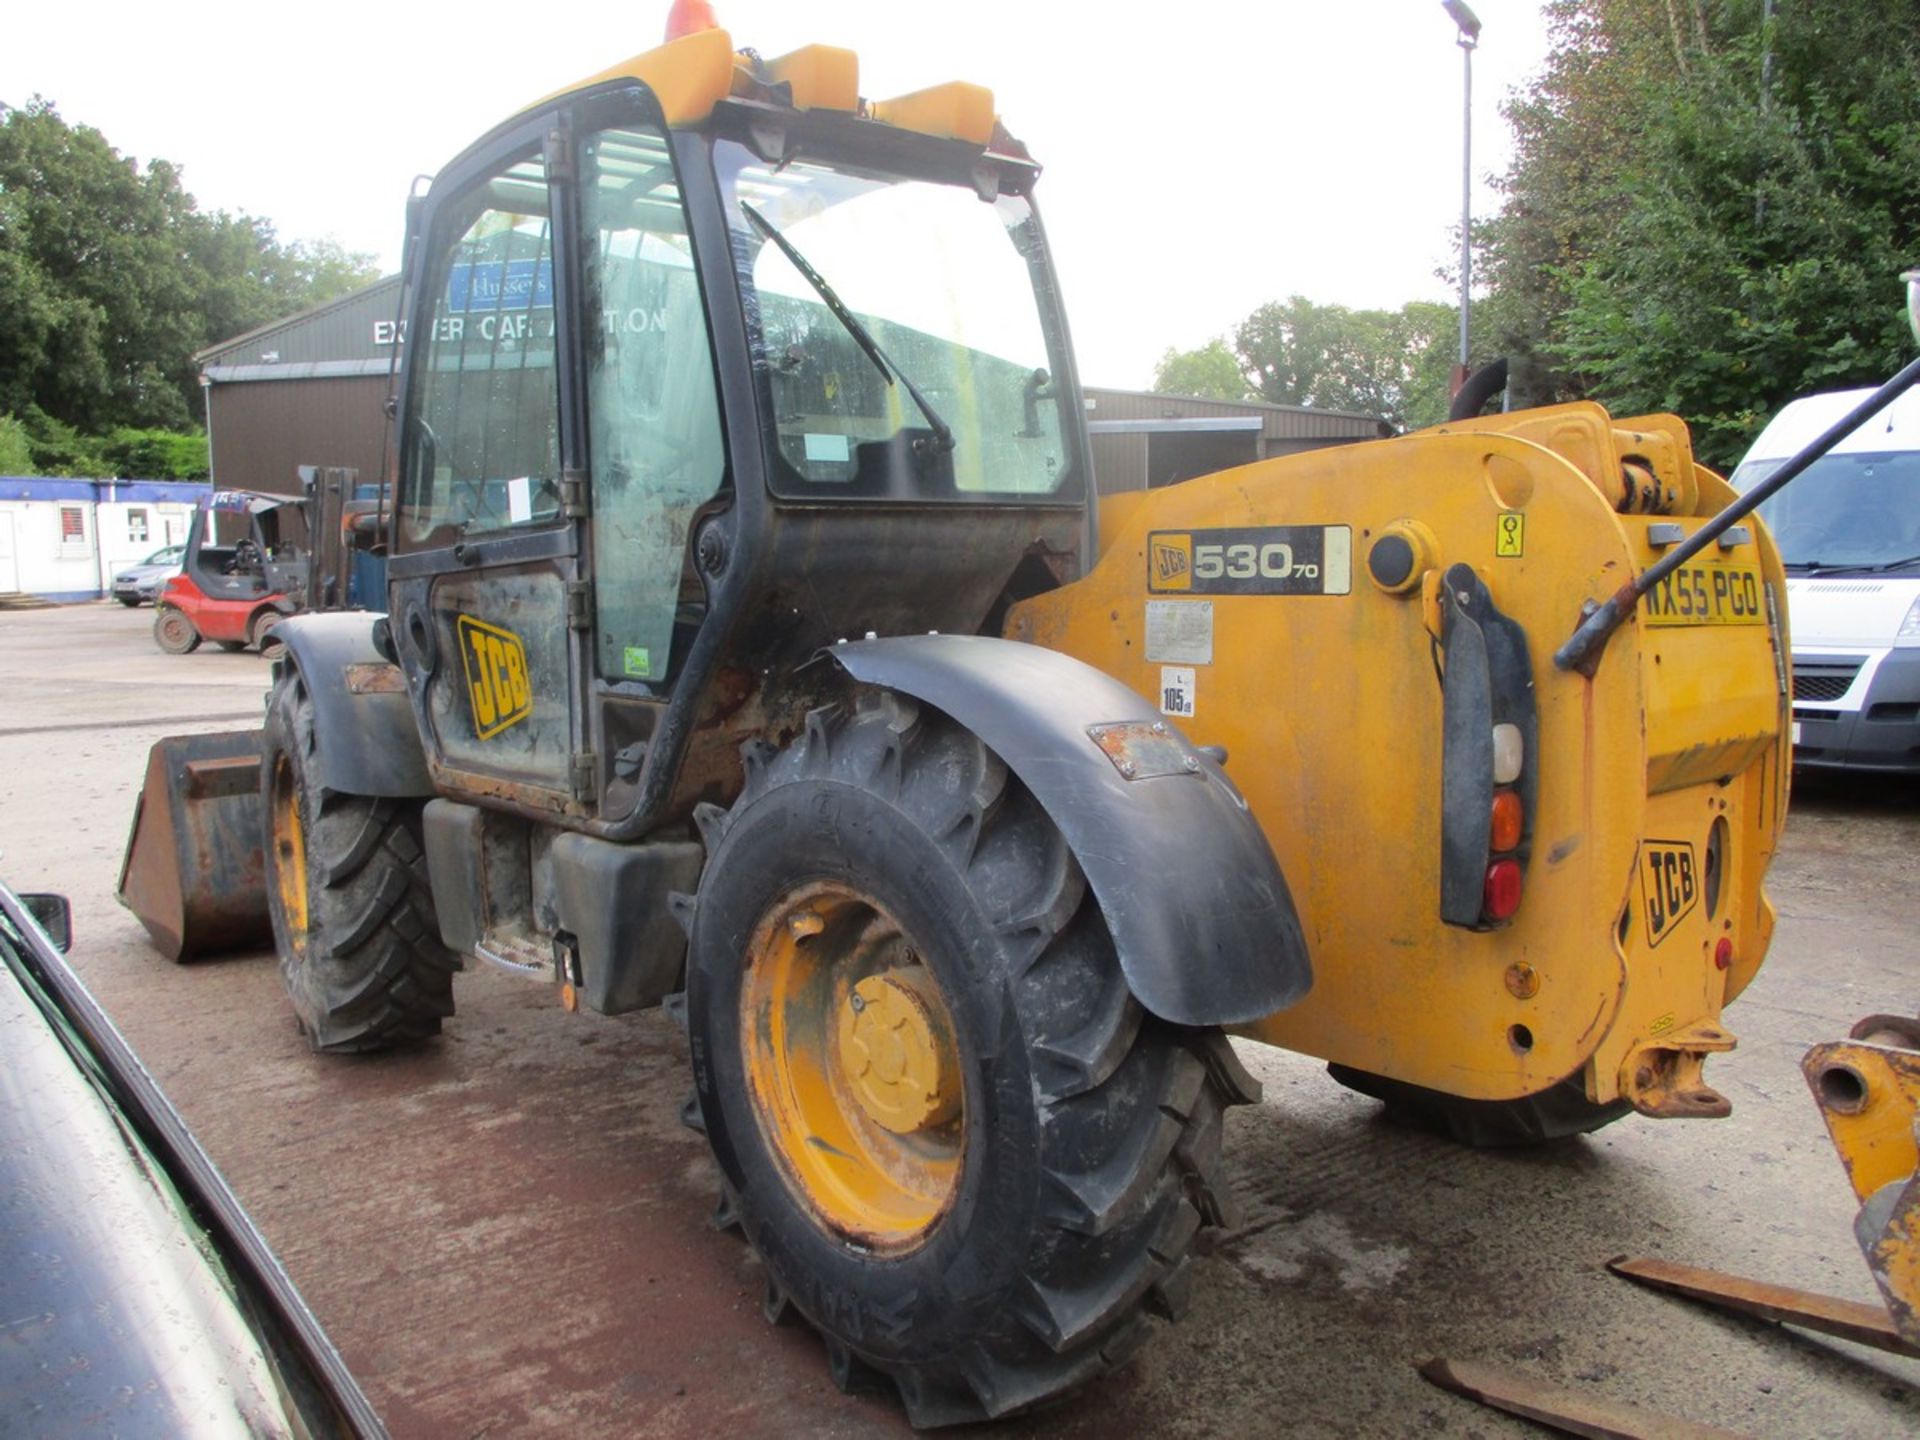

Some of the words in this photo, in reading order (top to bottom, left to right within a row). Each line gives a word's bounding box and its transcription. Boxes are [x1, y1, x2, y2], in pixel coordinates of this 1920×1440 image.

[373, 317, 465, 345] EXER
[1160, 548, 1187, 577] JCB
[1194, 543, 1294, 579] 530
[1293, 564, 1319, 579] 70
[1712, 570, 1759, 616] PGO
[469, 629, 527, 726] JCB
[1164, 687, 1184, 712] 105
[1648, 851, 1694, 935] JCB
